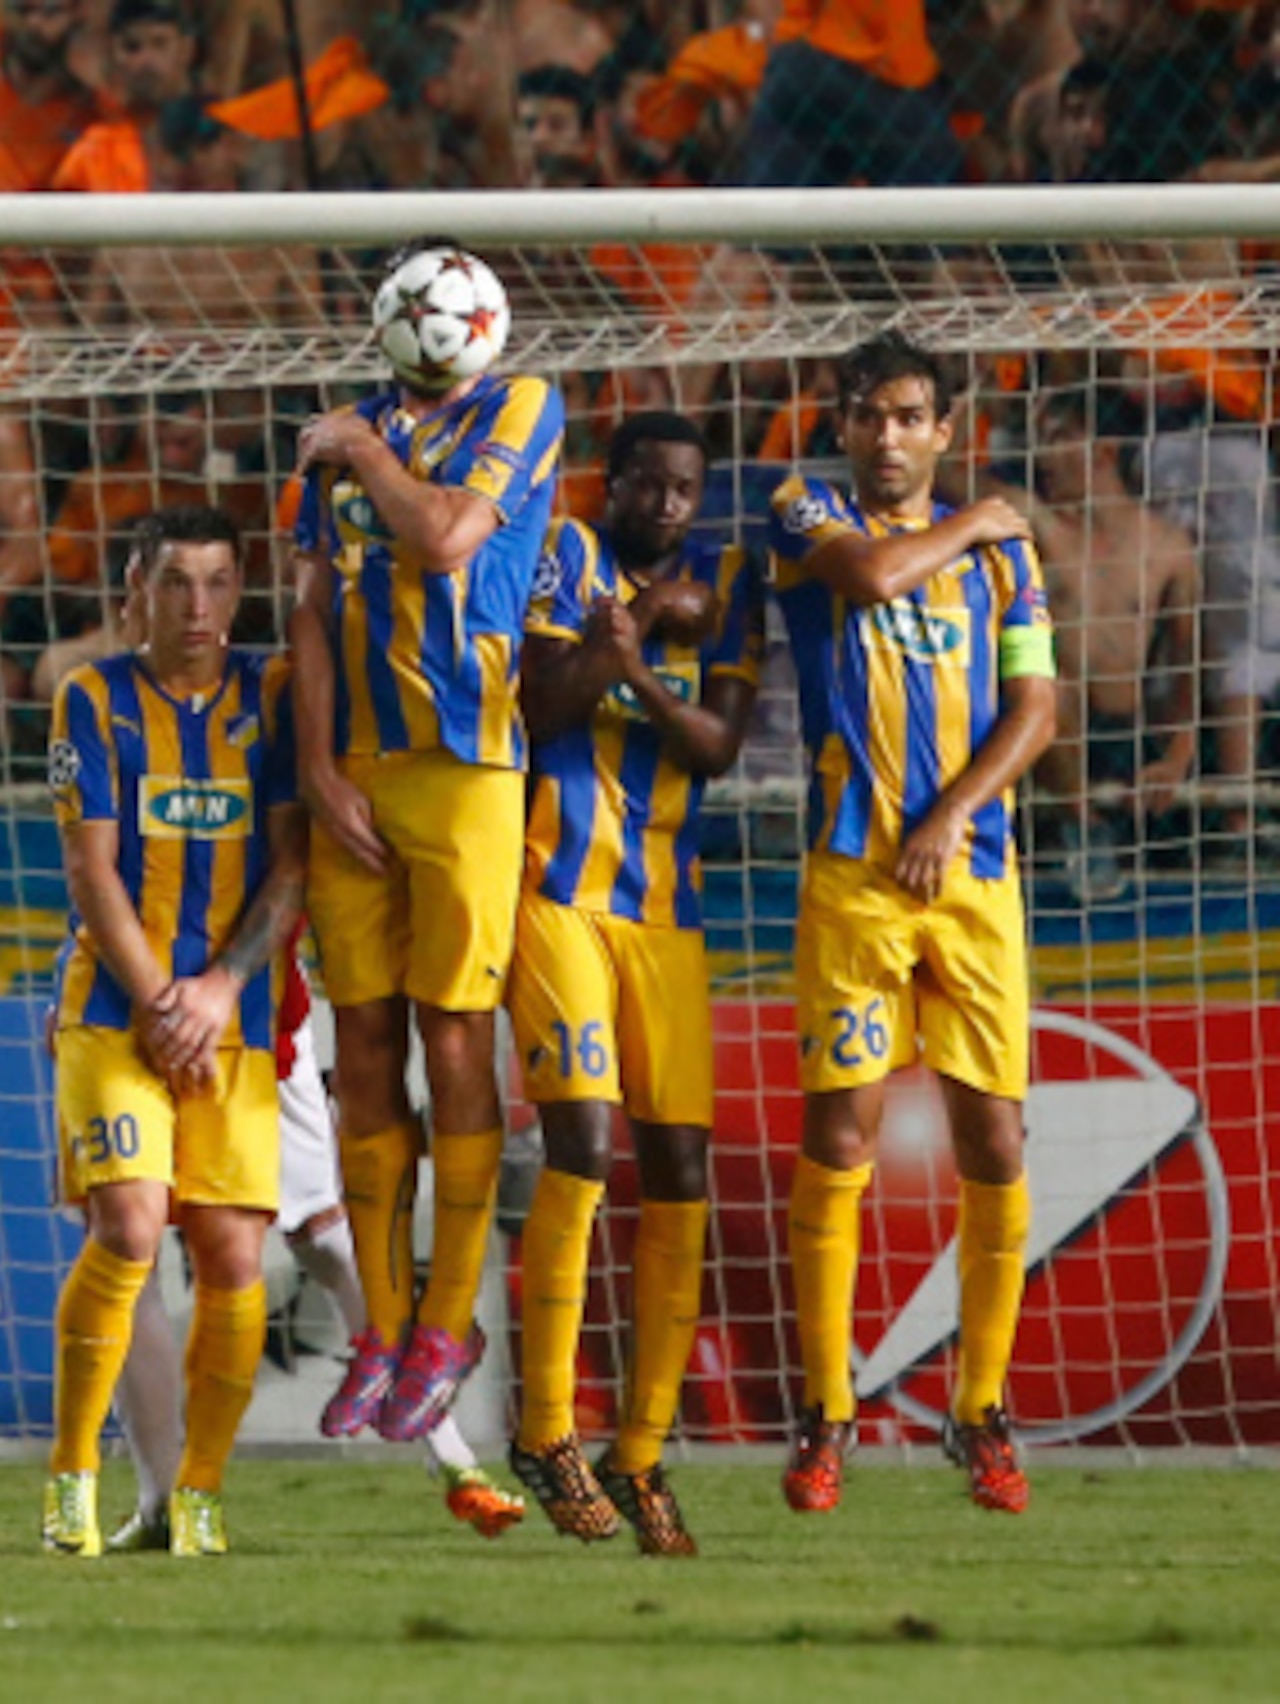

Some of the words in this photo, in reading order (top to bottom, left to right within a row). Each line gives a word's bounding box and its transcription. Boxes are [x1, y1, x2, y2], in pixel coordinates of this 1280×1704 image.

[551, 1019, 608, 1080] 16
[831, 997, 889, 1067] 26
[87, 1112, 140, 1164] 30
